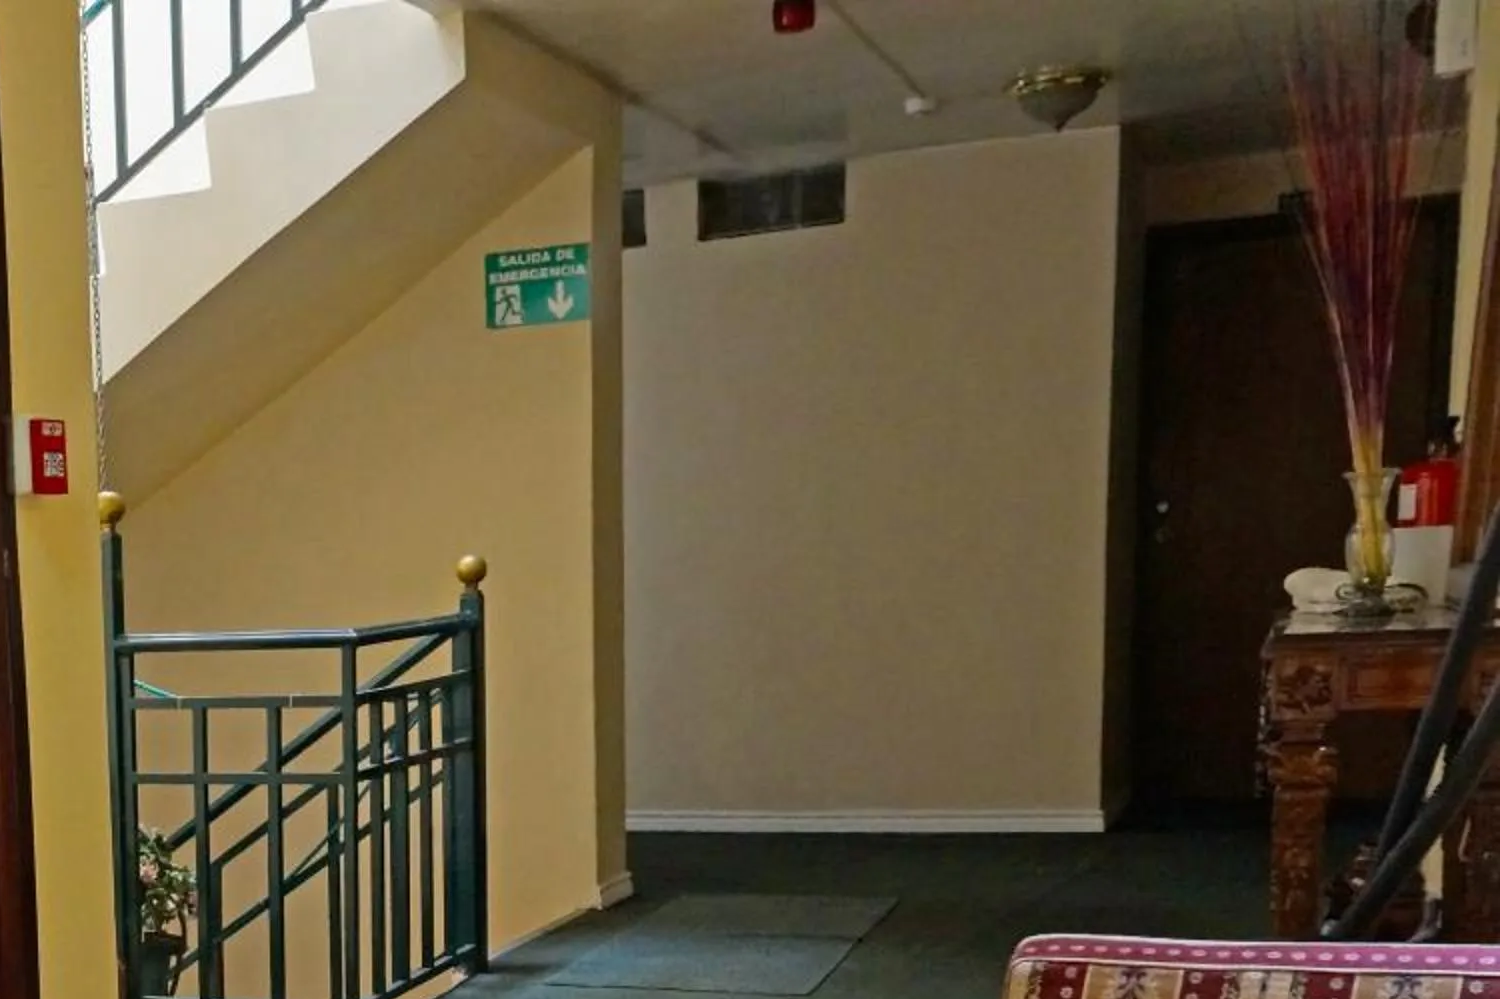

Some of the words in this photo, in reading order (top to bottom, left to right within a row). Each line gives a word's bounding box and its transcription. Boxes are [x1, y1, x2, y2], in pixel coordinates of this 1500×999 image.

[499, 251, 551, 267] SALIDA
[555, 248, 575, 261] DE
[489, 263, 587, 284] EMERGENCIA
